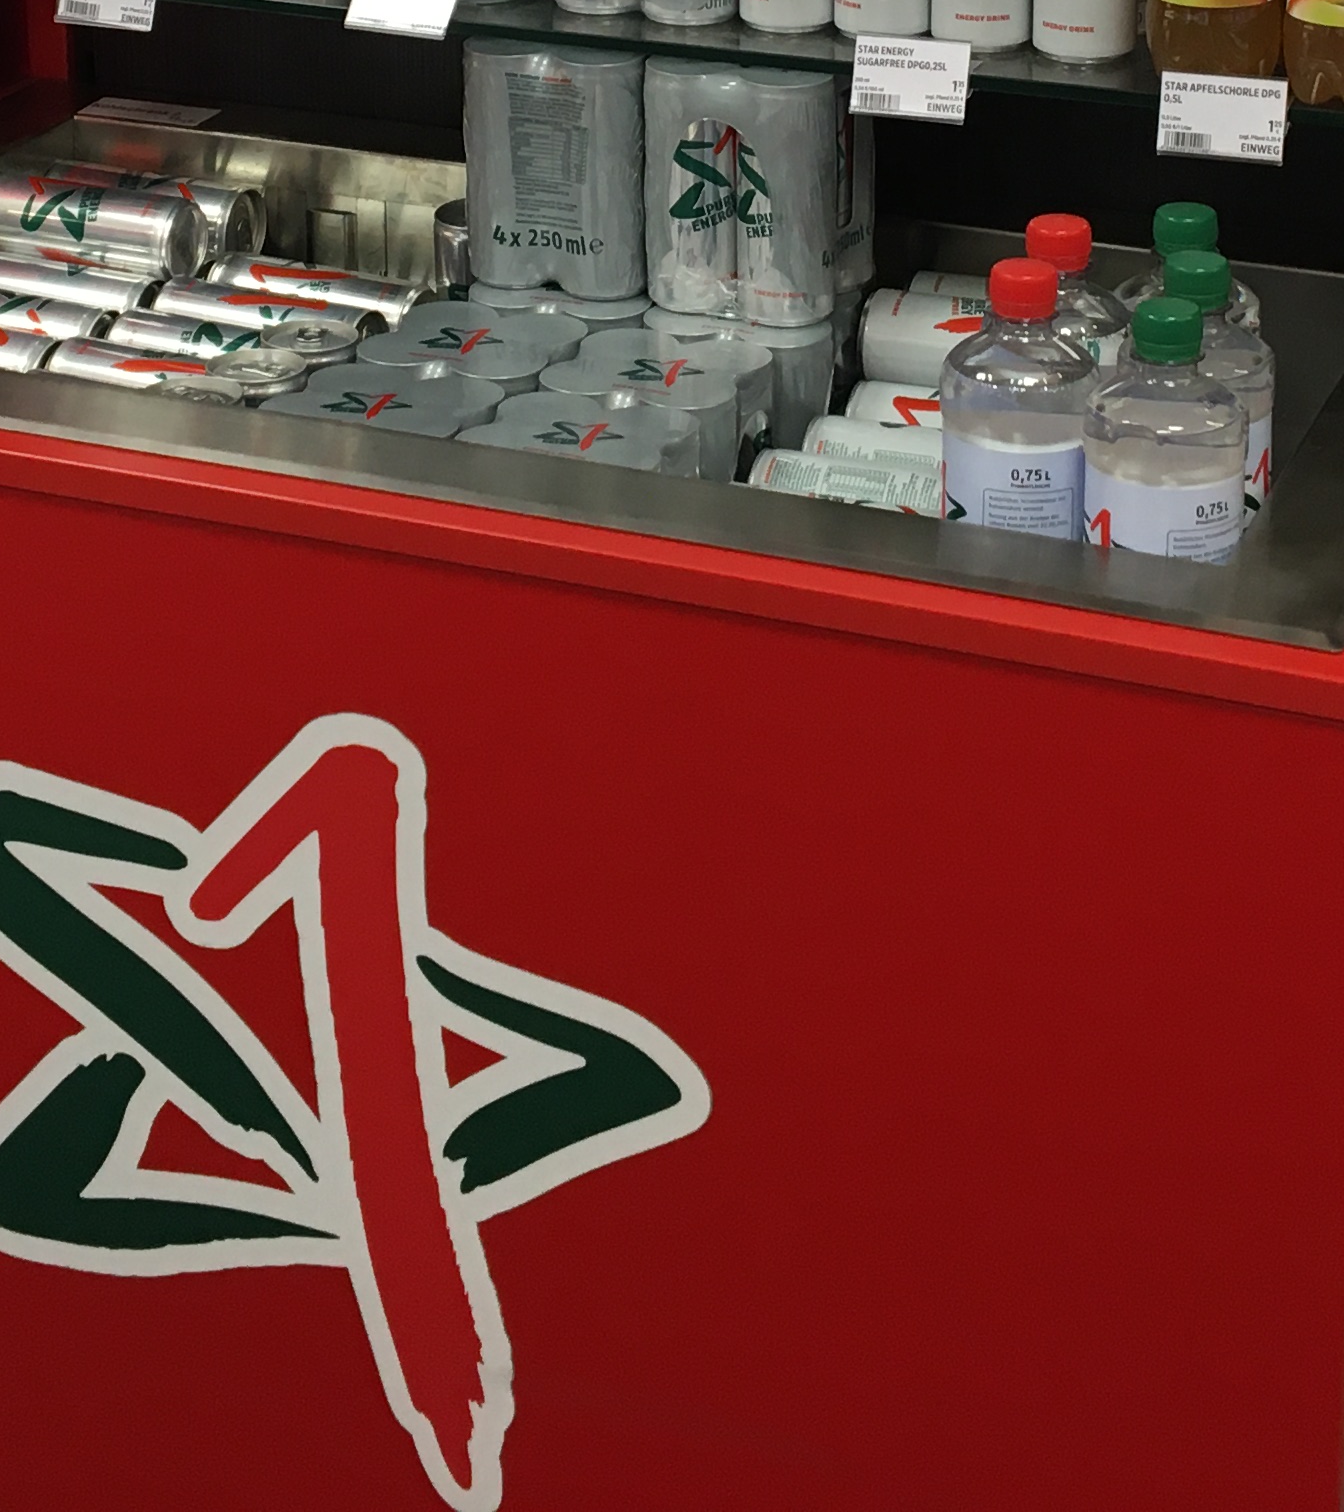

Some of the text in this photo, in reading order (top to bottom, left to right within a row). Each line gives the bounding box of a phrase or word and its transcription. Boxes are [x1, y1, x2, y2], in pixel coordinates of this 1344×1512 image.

[121, 14, 150, 26] EINWEG
[858, 45, 914, 57] STAR ENERGY
[857, 57, 905, 68] SUGARFREE
[1165, 81, 1280, 99] STAR APFELSCHORLE DPG
[927, 103, 962, 113] EINWEG
[1241, 143, 1280, 155] EINWEG
